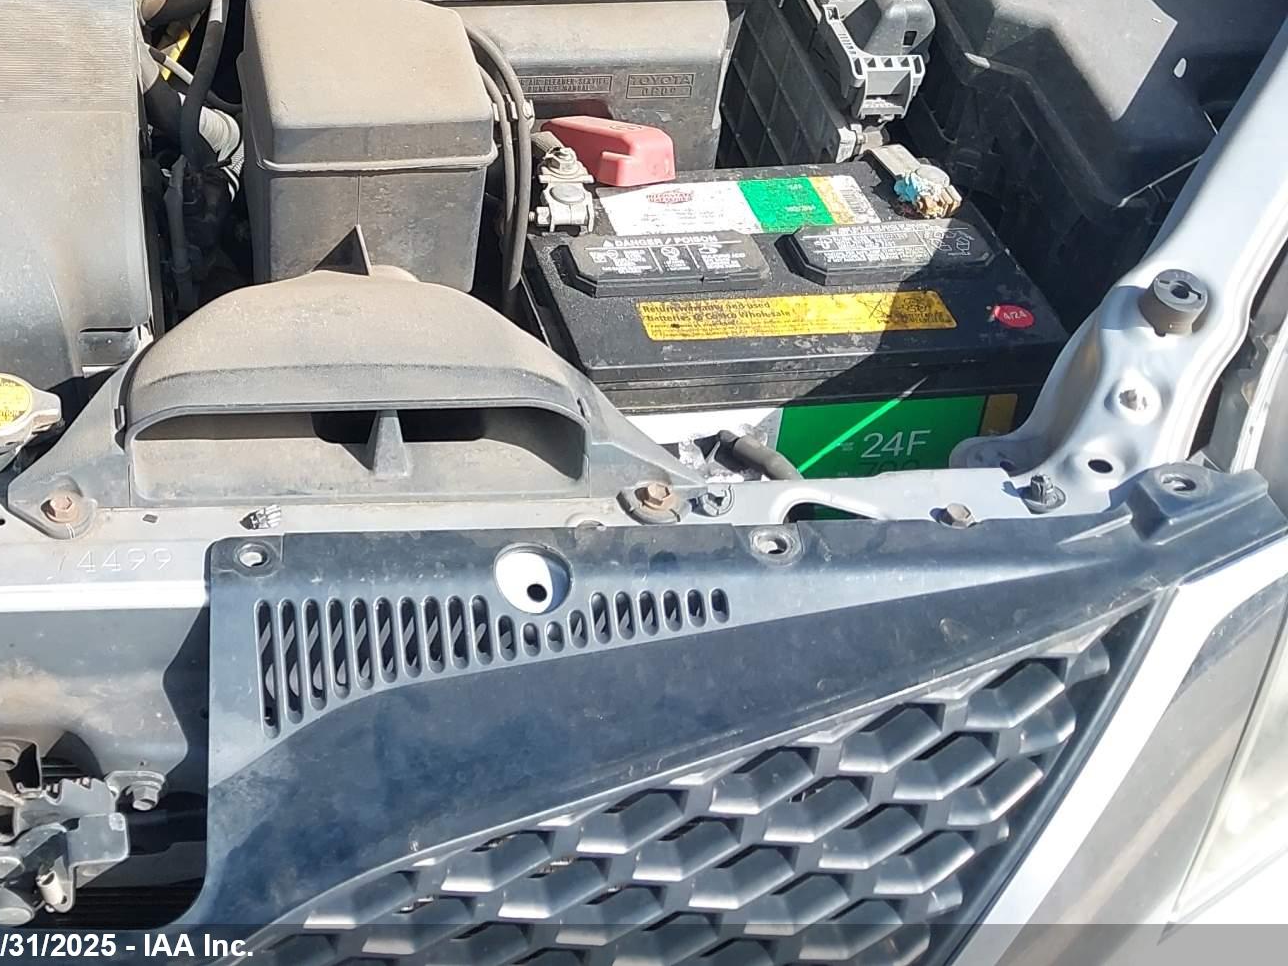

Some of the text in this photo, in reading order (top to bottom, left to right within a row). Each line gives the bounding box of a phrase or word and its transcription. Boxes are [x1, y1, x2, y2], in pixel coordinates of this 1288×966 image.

[630, 75, 691, 85] TOYOTA
[614, 238, 663, 247] DANGER
[673, 235, 719, 244] POISON
[739, 310, 792, 320] Wholesale
[860, 429, 931, 459] 24F
